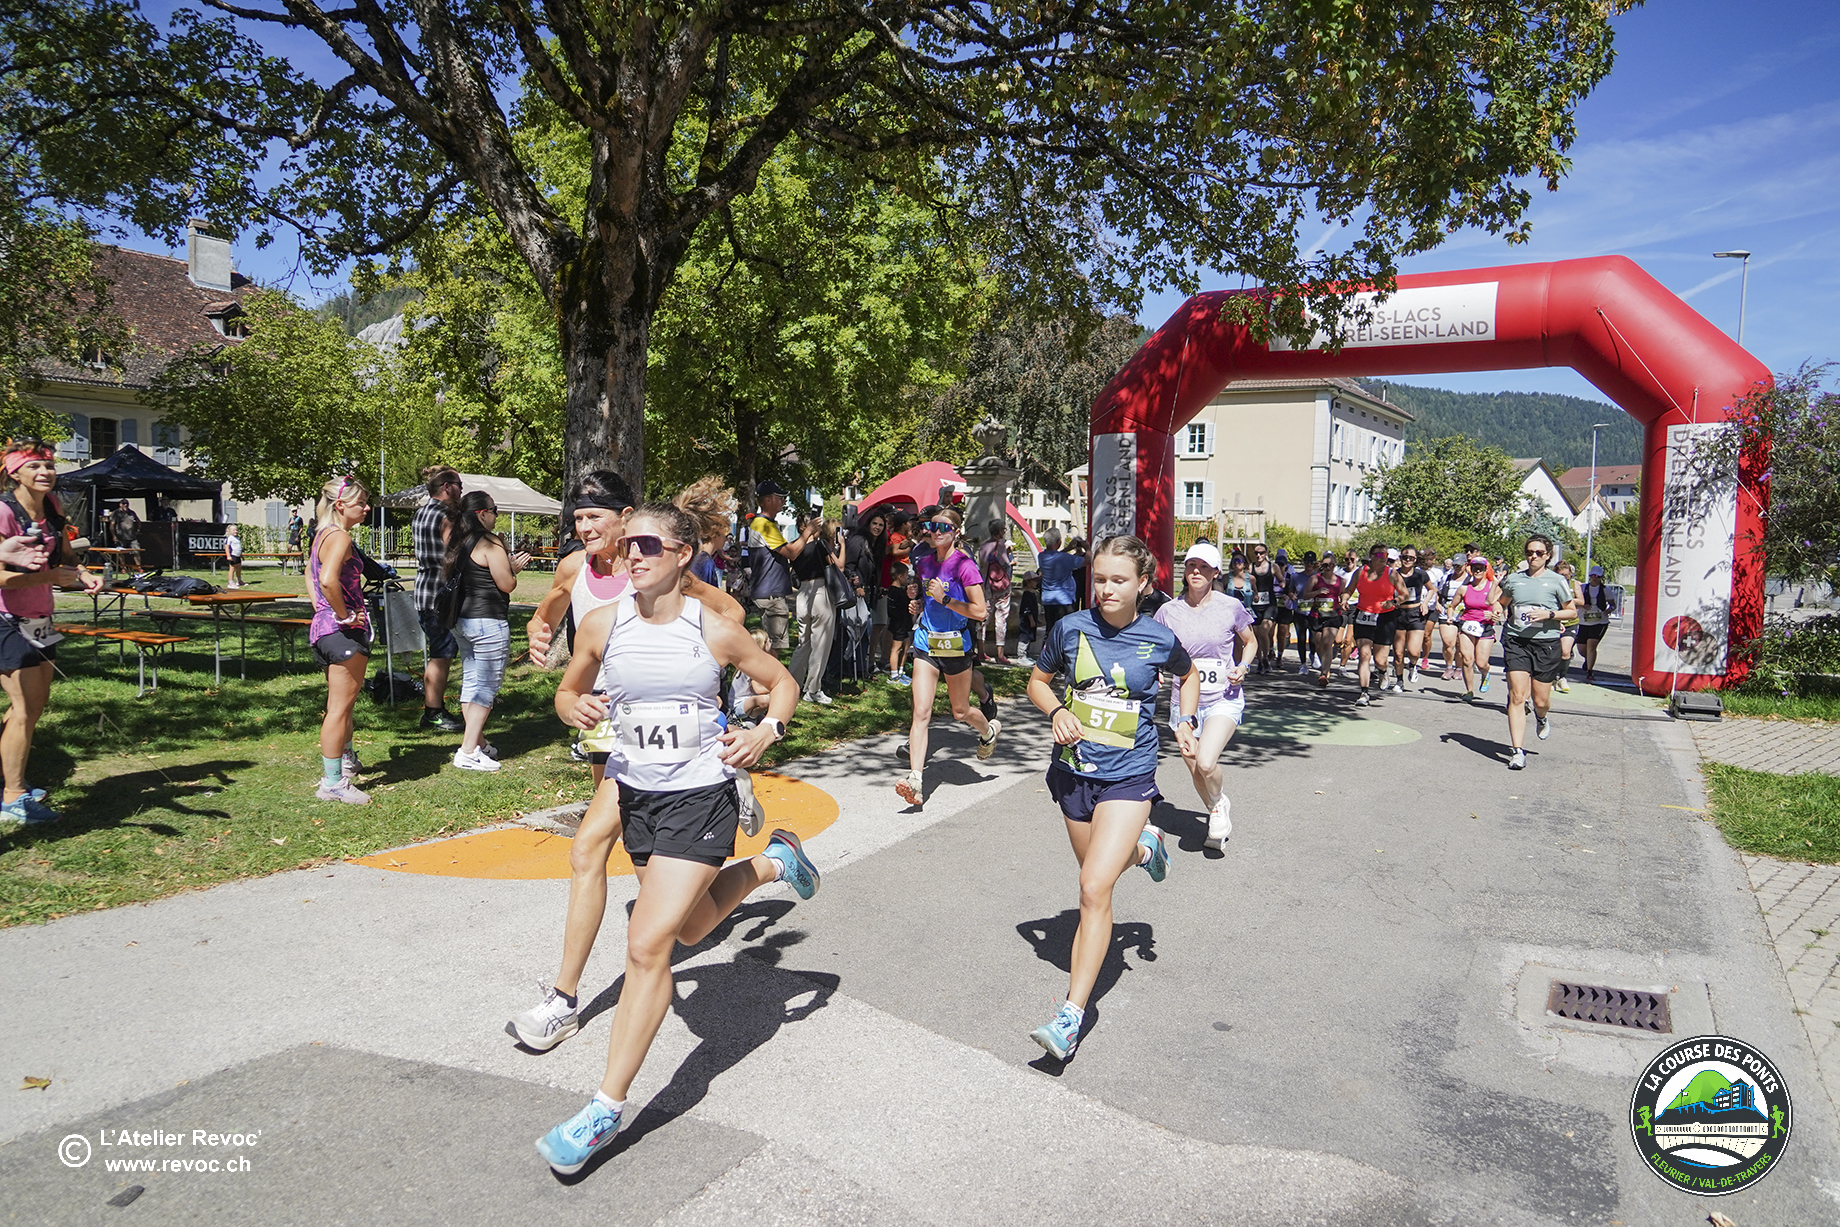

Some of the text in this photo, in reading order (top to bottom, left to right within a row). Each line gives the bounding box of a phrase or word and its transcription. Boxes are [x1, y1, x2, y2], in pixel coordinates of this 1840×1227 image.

[937, 640, 952, 650] 48
[1198, 670, 1217, 684] 08
[1089, 708, 1118, 730] 57
[634, 724, 679, 750] 141
